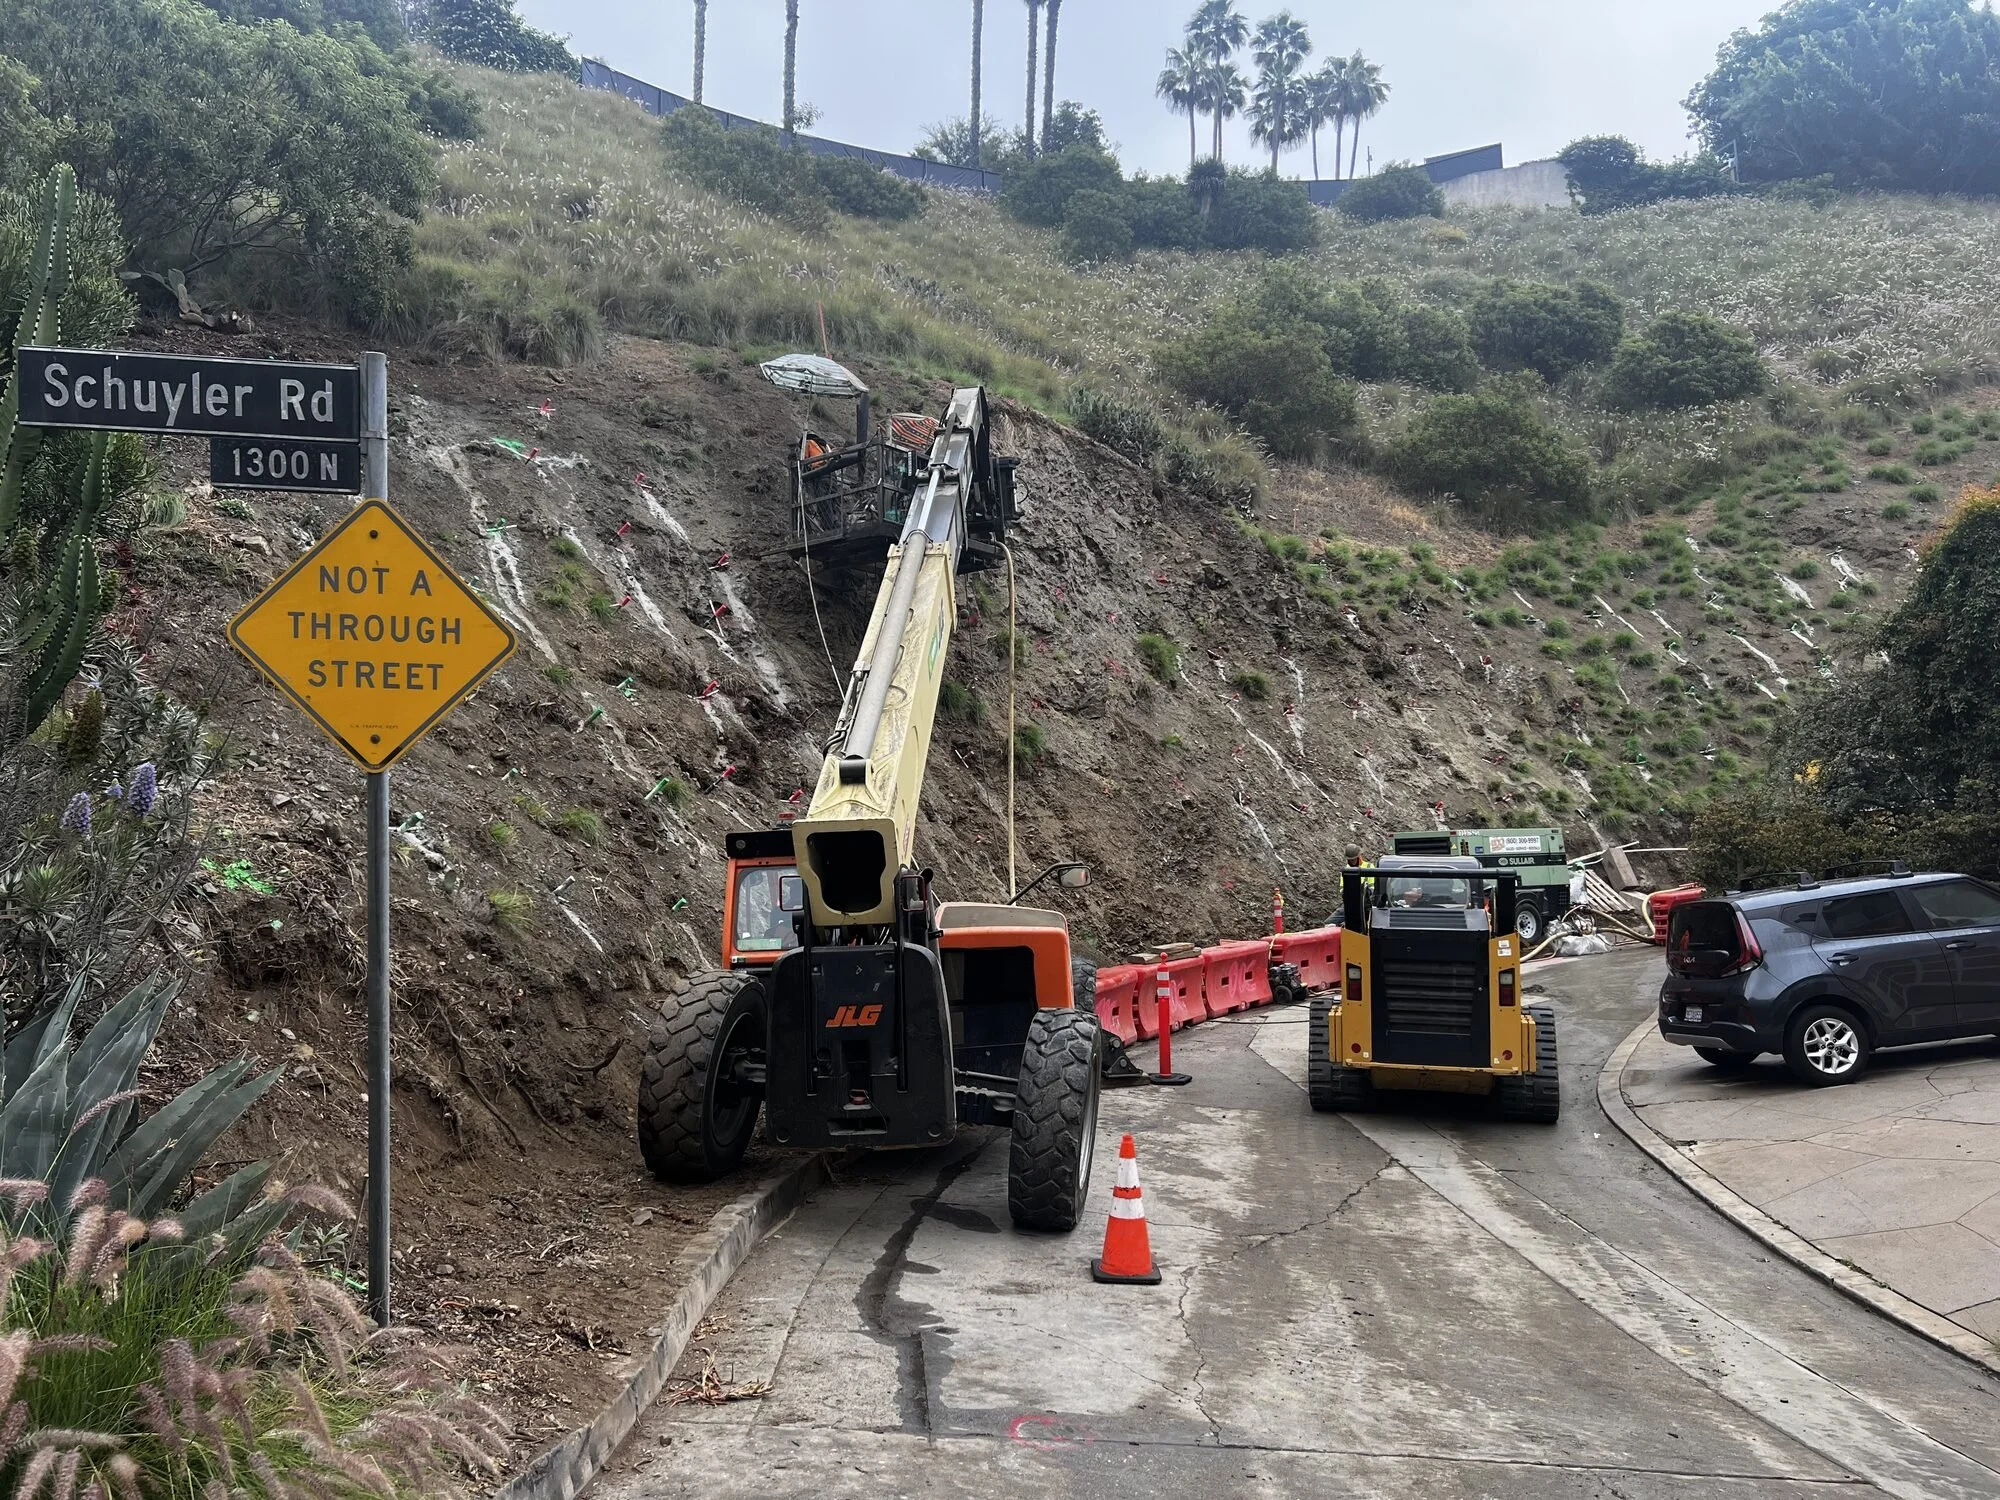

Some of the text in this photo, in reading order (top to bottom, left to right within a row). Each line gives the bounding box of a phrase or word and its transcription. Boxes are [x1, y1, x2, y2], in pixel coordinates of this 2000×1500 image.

[43, 362, 335, 427] Schuyler Rd
[232, 446, 339, 481] 1300 N
[318, 565, 433, 597] NOT A
[287, 611, 461, 645] THROUGH
[307, 659, 444, 691] STREET
[1509, 857, 1535, 866] SULLAIR
[826, 1003, 884, 1028] JLG
